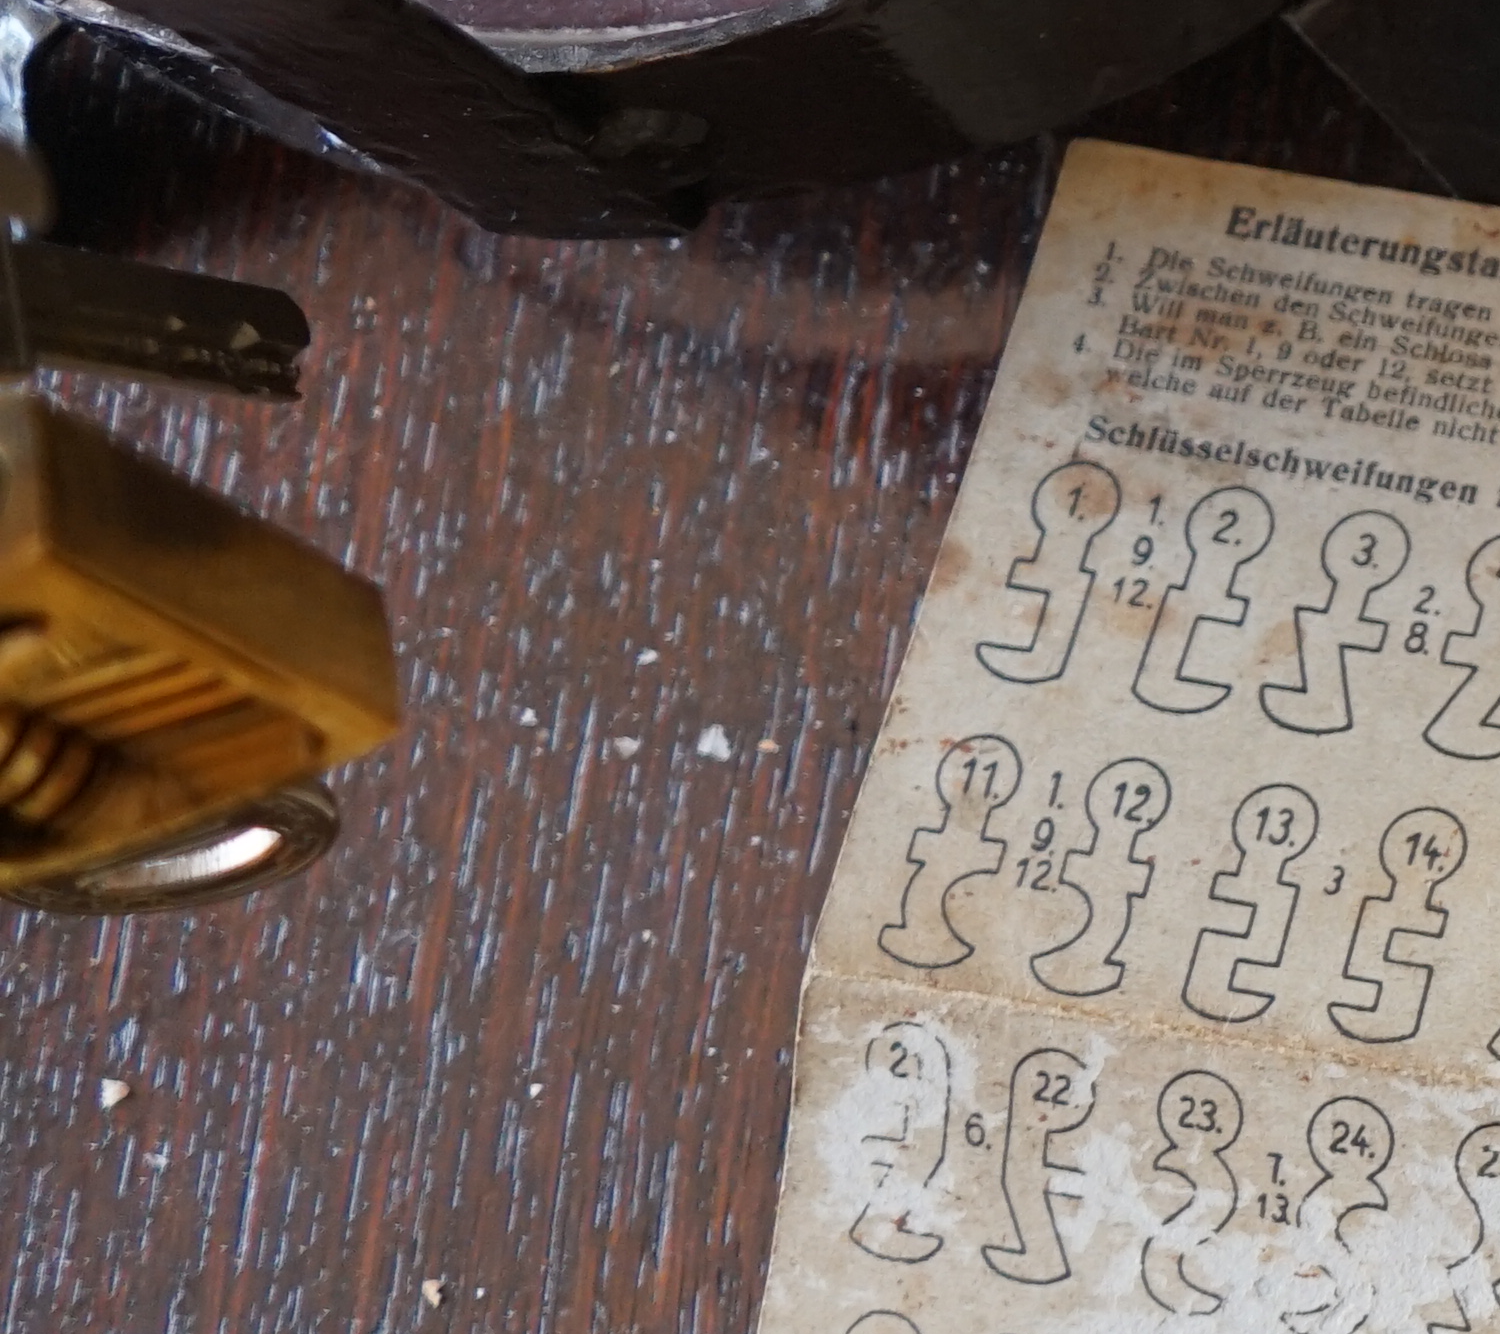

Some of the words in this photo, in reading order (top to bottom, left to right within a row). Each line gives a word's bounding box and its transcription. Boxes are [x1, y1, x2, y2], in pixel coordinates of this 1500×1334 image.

[1133, 269, 1261, 310] Zwischen
[1206, 256, 1393, 305] Schweifungen
[1406, 291, 1492, 322] tragen
[1215, 355, 1356, 400] Sperrzeug
[1300, 346, 1366, 374] oder
[1424, 368, 1494, 395] setzt
[1321, 395, 1420, 431] Tabelle
[1432, 417, 1500, 446] nicht
[1084, 414, 1479, 505] Schlüsselschweifungen
[1065, 483, 1090, 521] 1.
[1211, 509, 1242, 546] 2.
[1350, 531, 1382, 569] 3.
[1113, 576, 1153, 611] 12.
[1412, 585, 1441, 616] 2.
[958, 755, 1002, 800] 11.
[1113, 781, 1158, 828] 12.
[1252, 805, 1298, 848] 13.
[1405, 831, 1450, 873] 14.
[1016, 857, 1065, 894] 12.
[1031, 1070, 1079, 1109] 22.
[962, 1111, 995, 1151] 6.
[1178, 1095, 1223, 1134] 23.
[1328, 1120, 1376, 1159] 24.
